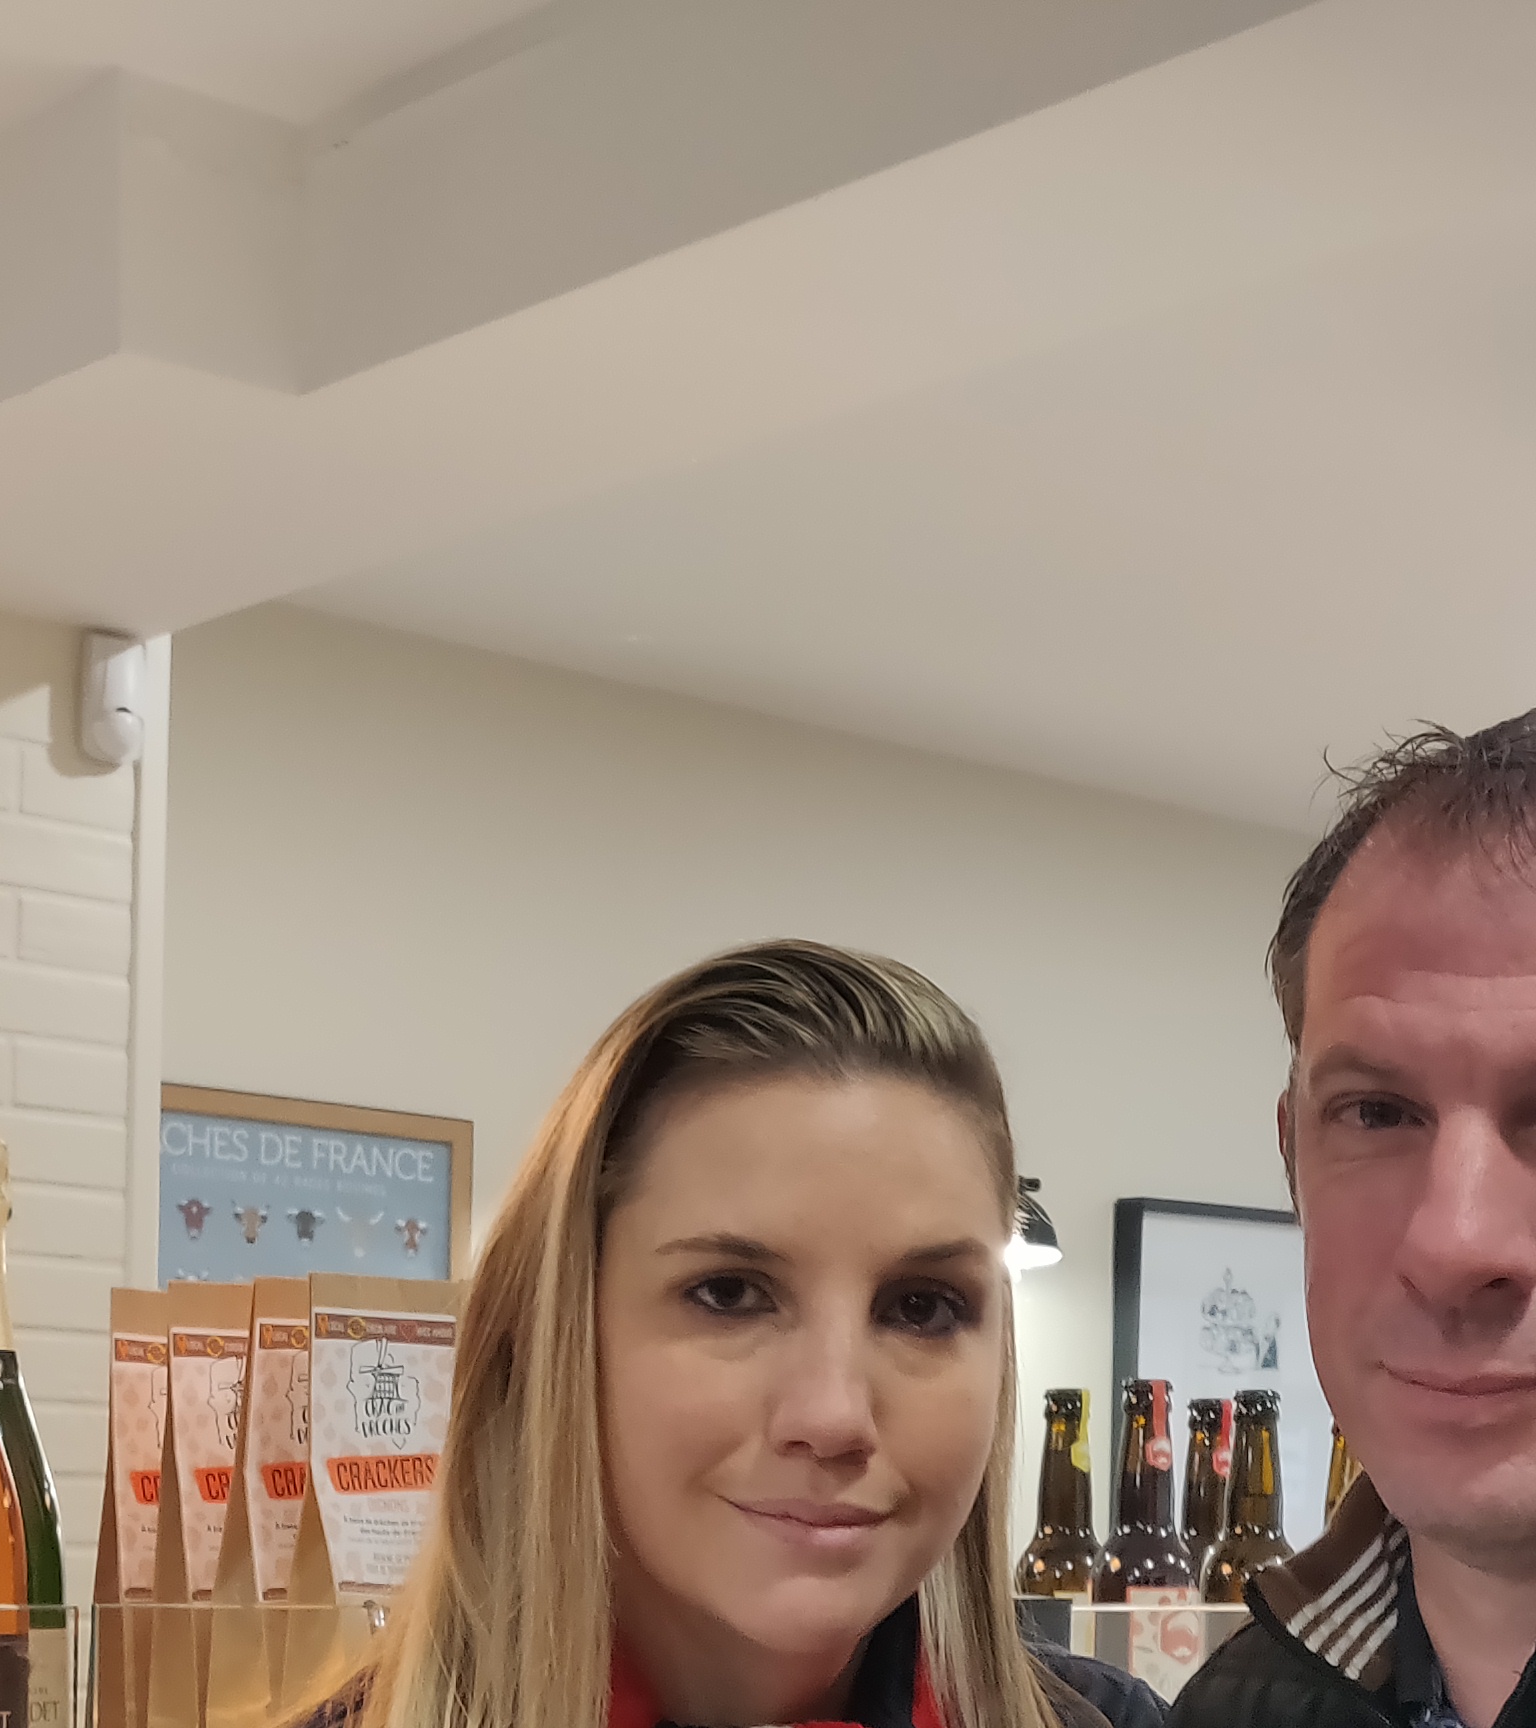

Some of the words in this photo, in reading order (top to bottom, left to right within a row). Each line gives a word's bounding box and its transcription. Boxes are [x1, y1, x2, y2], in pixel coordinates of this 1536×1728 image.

[260, 1133, 303, 1168] DE
[313, 1138, 434, 1183] FRANCE
[337, 1456, 435, 1492] CRACKERS
